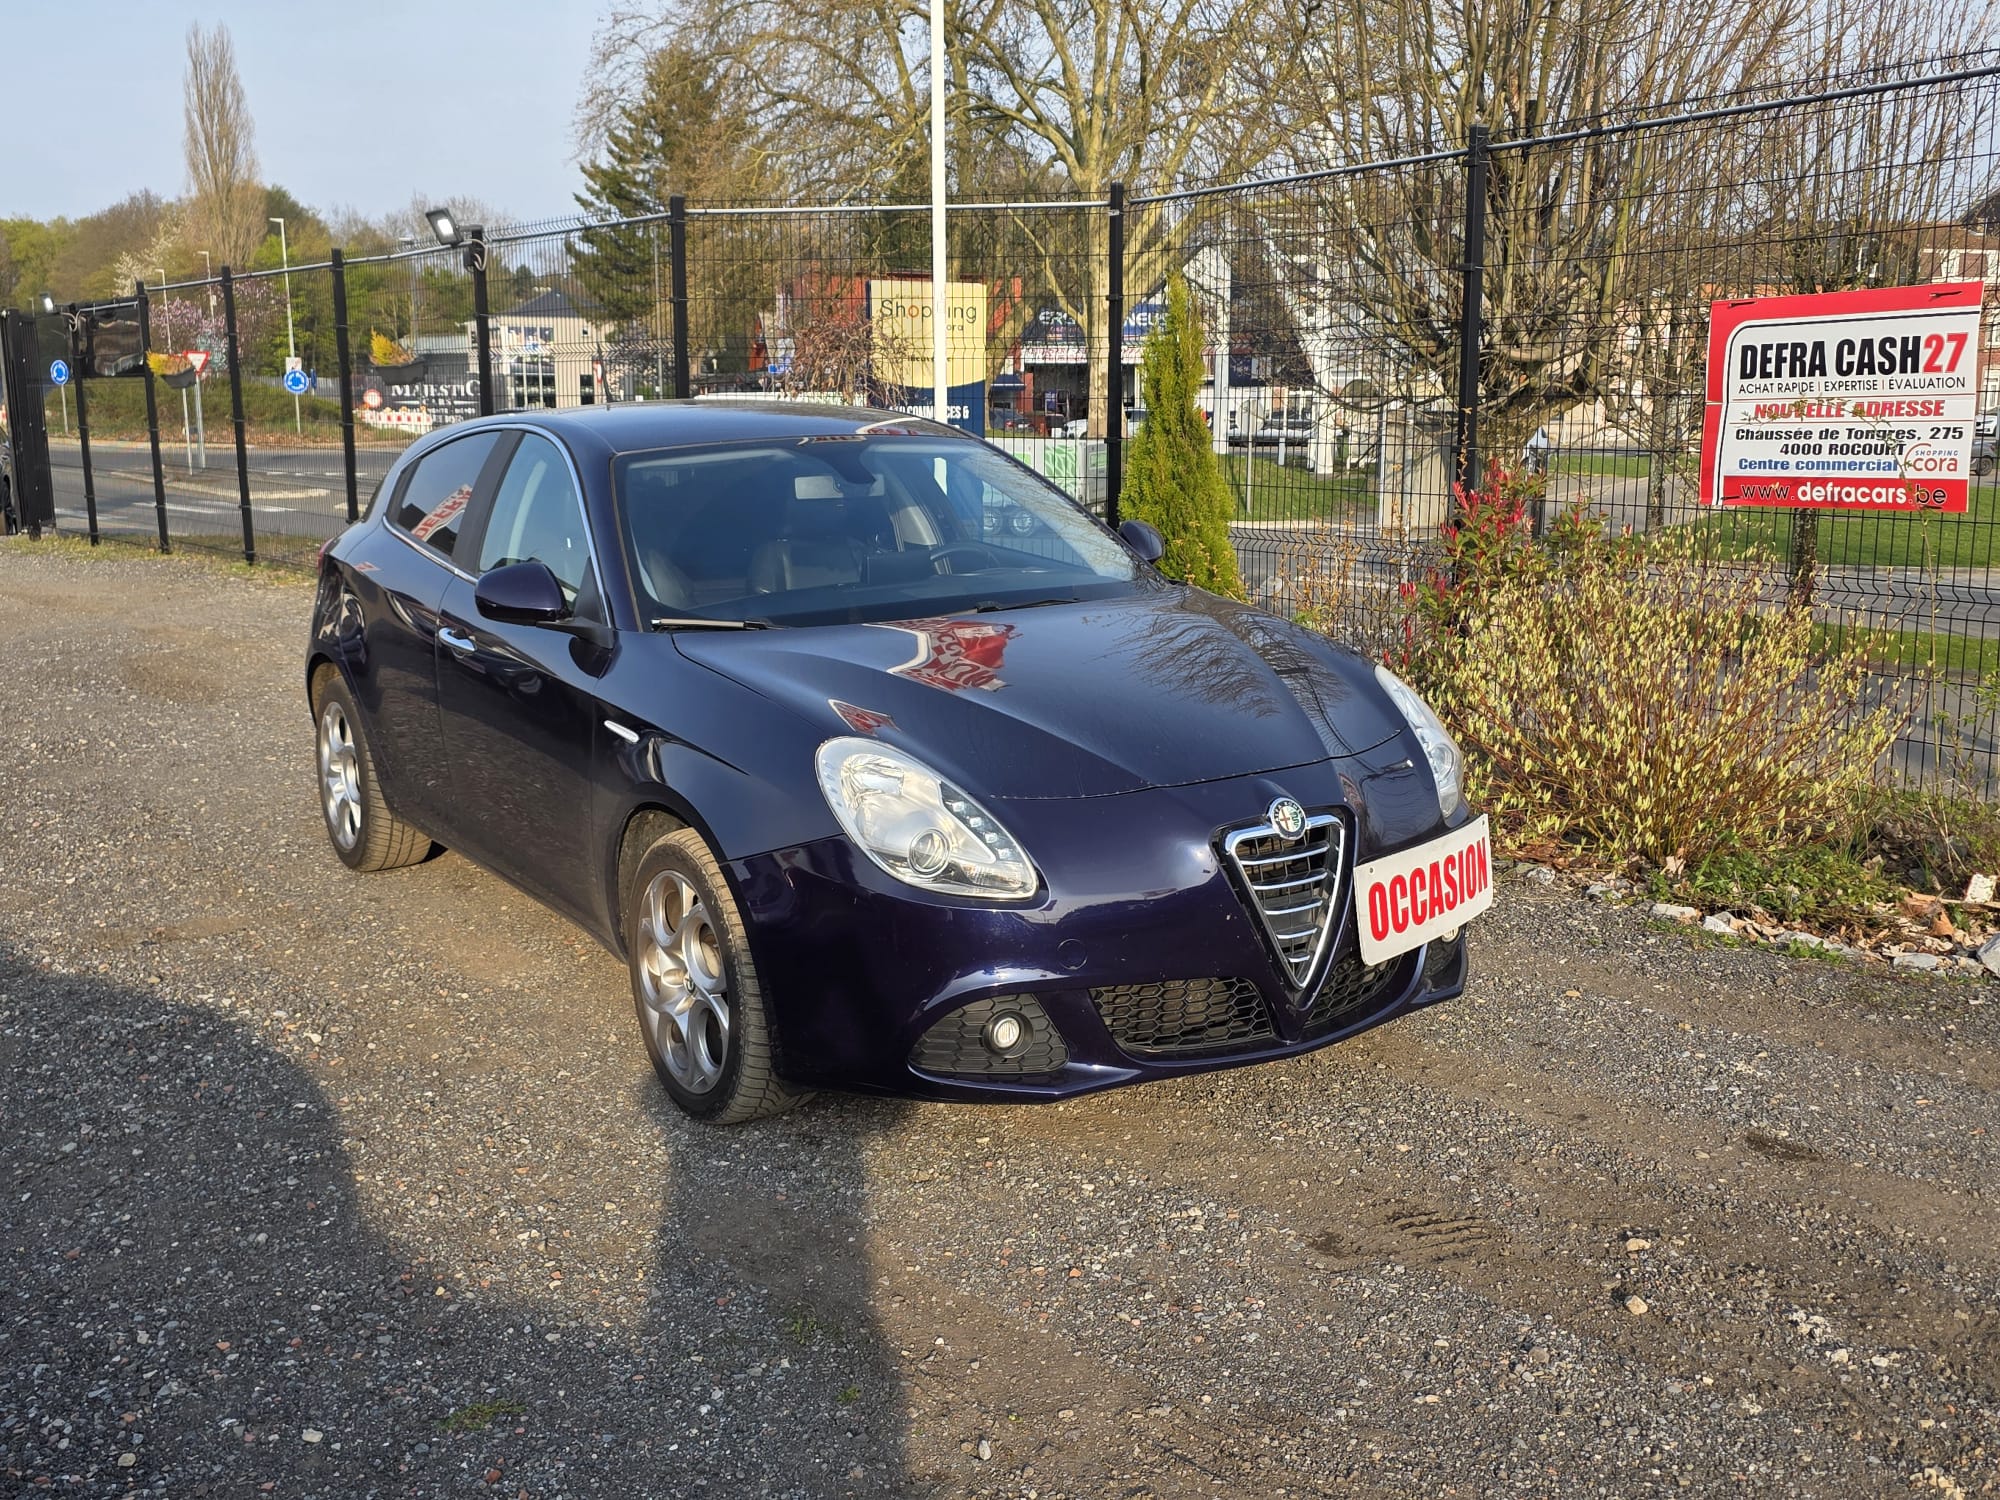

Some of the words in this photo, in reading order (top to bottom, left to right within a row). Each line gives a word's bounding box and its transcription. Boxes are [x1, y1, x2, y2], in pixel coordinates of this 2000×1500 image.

[881, 300, 977, 323] Shoping
[1740, 341, 1827, 379] DEFRA
[1738, 383, 1775, 394] ACHAT
[1777, 381, 1815, 393] RAPIDE
[1824, 379, 1878, 392] EXPERTISE
[1888, 376, 1966, 390] ÉVALUATION
[1754, 402, 1845, 418] NOUVELLE
[1851, 400, 1946, 417] ADRESSE
[1735, 427, 1813, 440] Chaussée
[1818, 427, 1840, 440] de
[1847, 427, 1922, 442] Tongres,
[1929, 426, 1964, 440] 275
[1780, 443, 1823, 456] 4000
[1828, 443, 1907, 456] ROCOURT
[1738, 458, 1790, 471] Centre
[1795, 458, 1898, 472] commercial
[1912, 458, 1958, 472] cora
[1368, 836, 1488, 942] OCCASION
